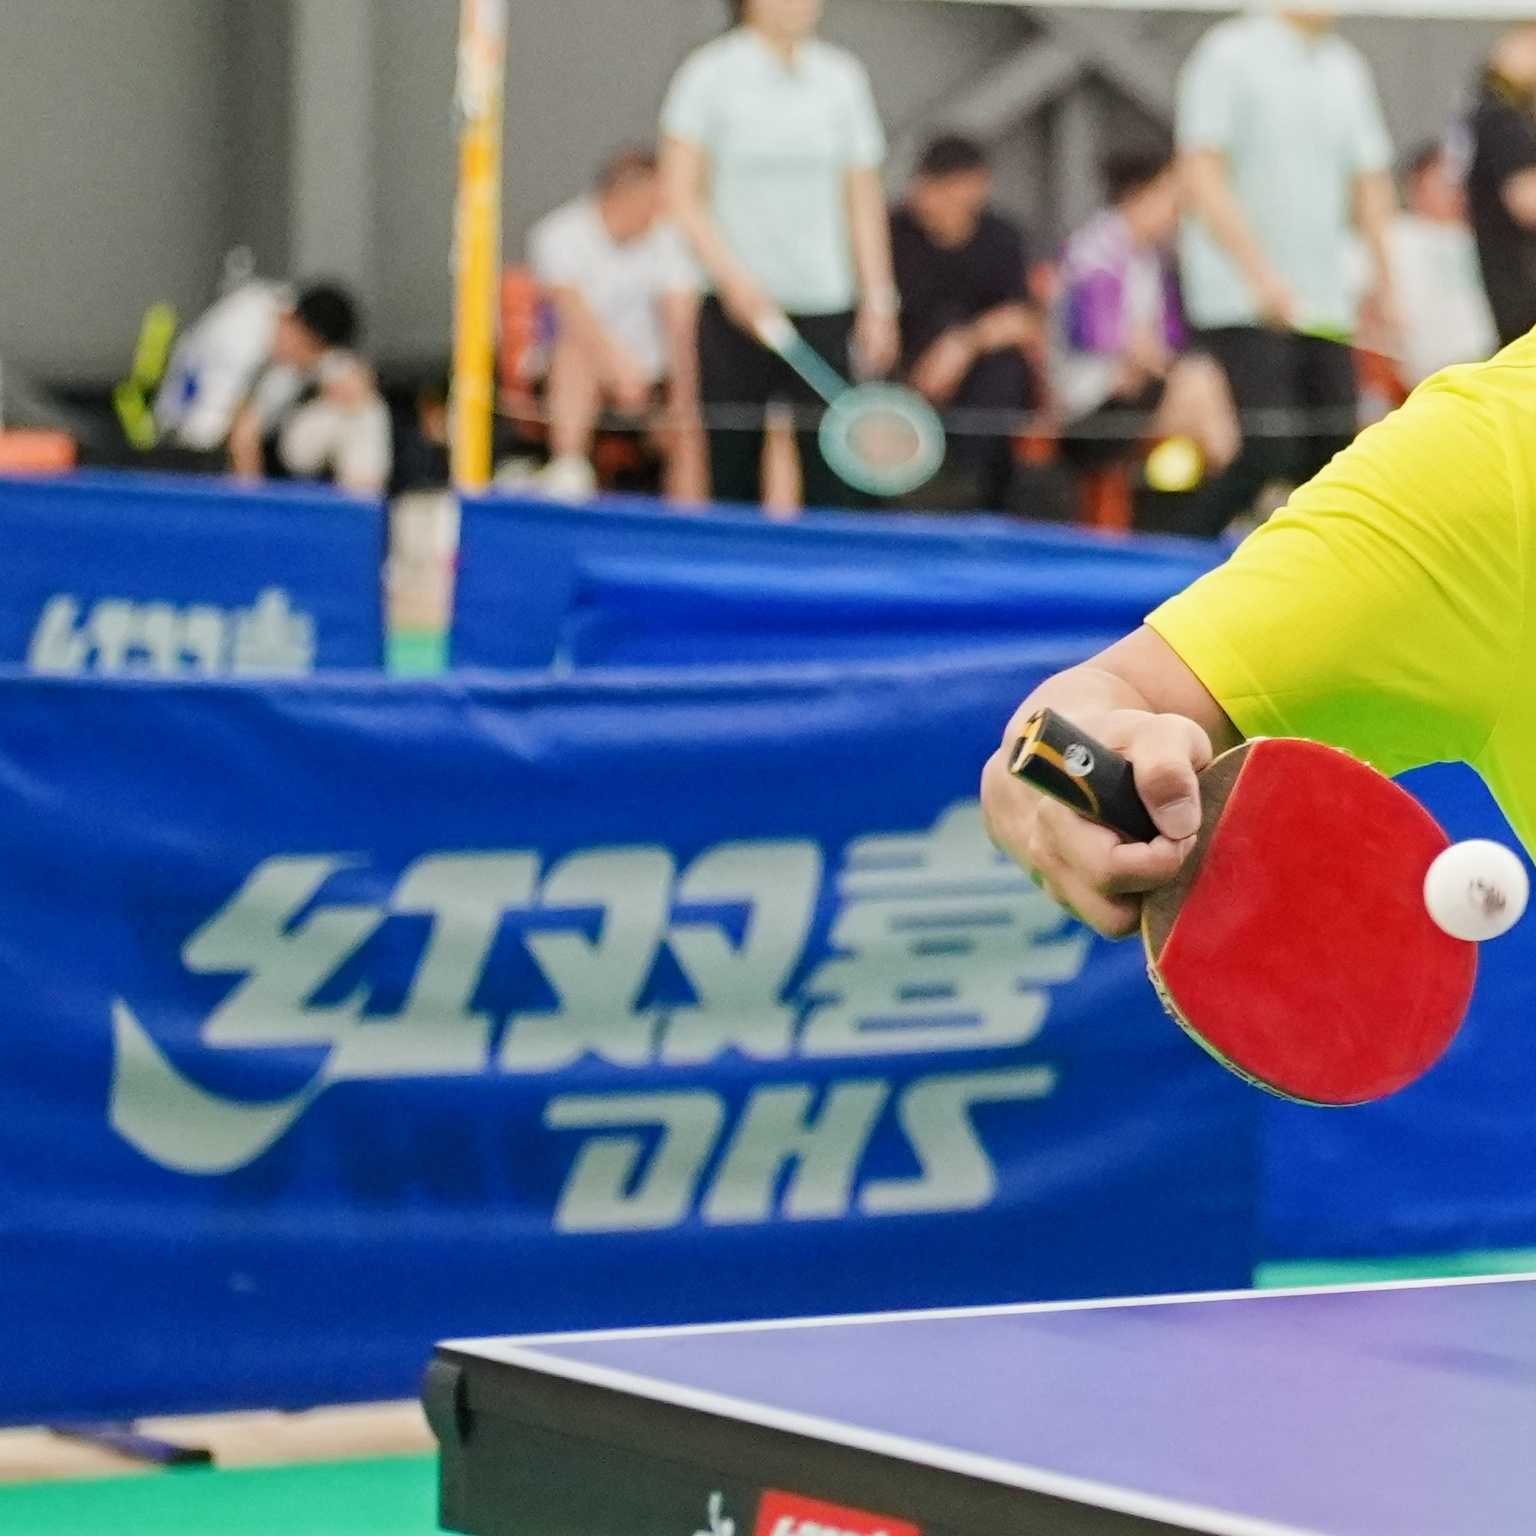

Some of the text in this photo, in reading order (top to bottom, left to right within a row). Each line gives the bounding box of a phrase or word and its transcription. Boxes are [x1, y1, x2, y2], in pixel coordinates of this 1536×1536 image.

[182, 800, 1092, 1080] 红双喜
[542, 1066, 1058, 1234] DHS
